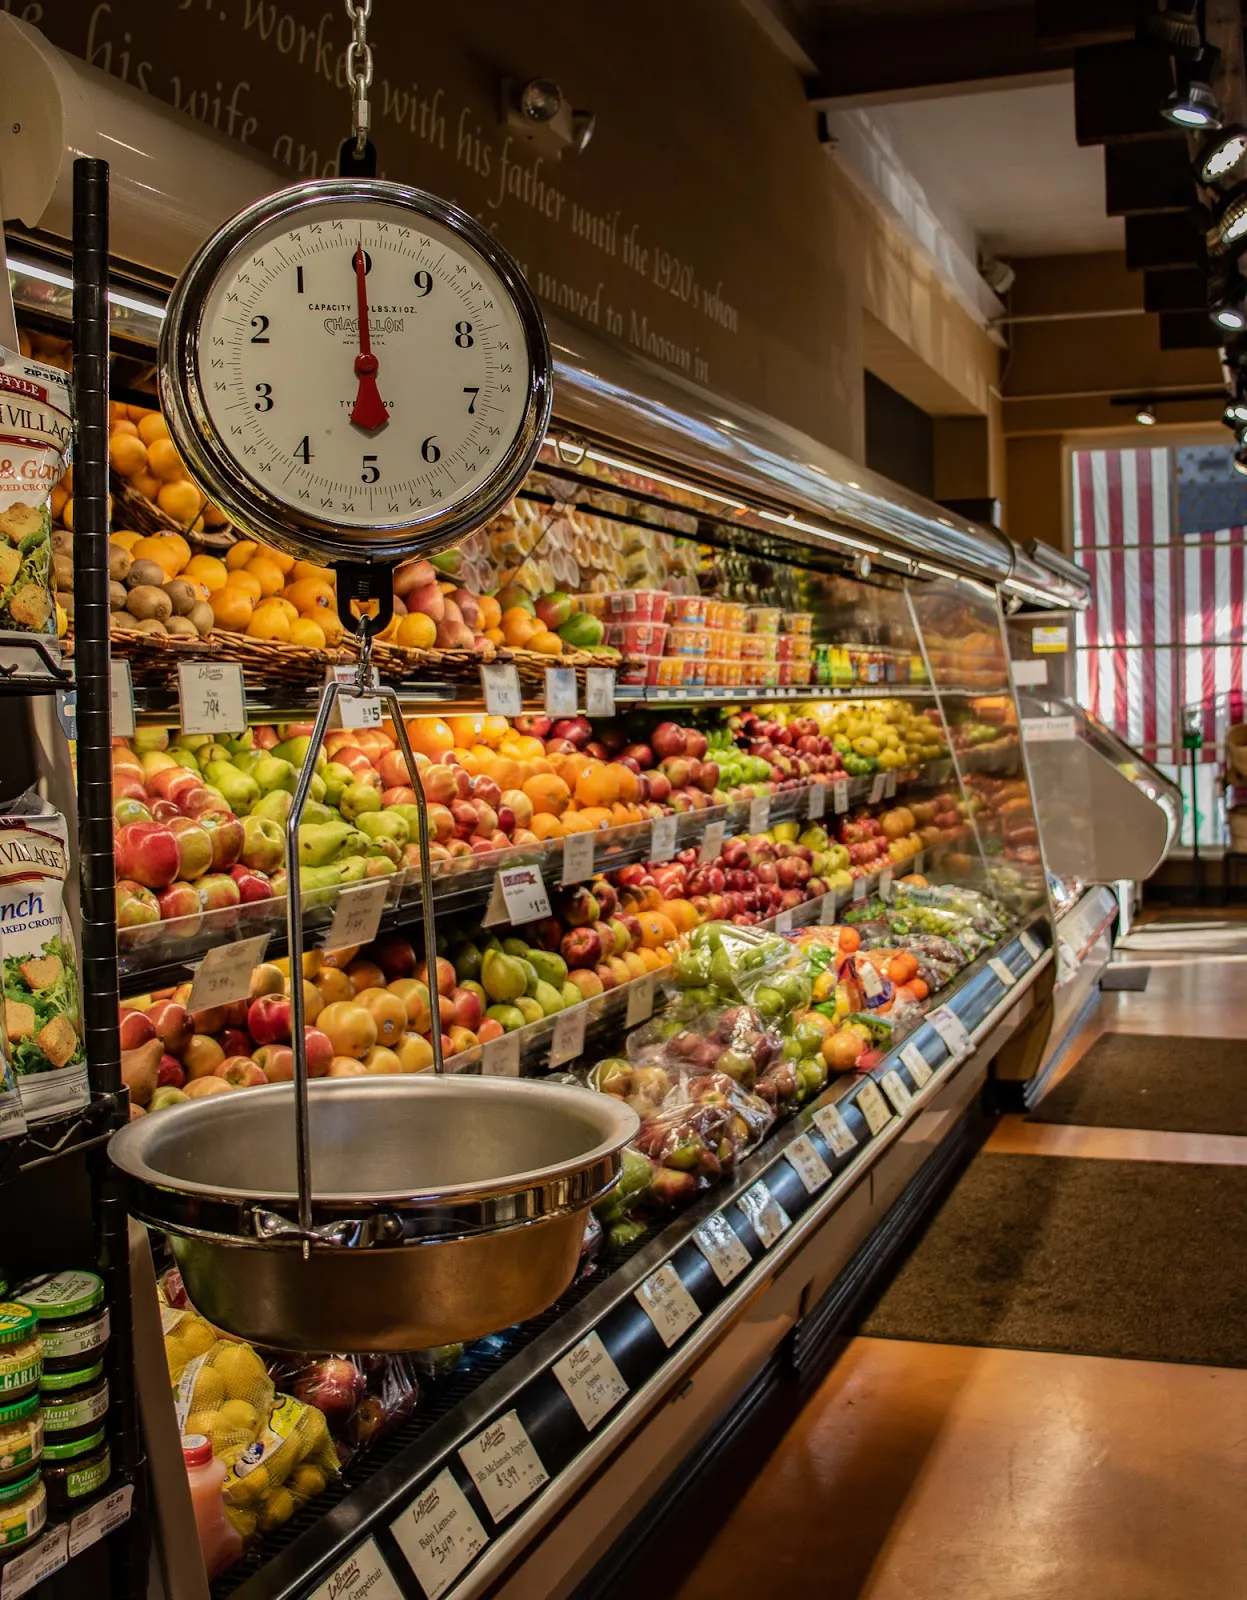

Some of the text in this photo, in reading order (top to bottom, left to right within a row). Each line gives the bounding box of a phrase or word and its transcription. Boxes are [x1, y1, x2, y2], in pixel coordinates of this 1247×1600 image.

[382, 79, 446, 150] with
[457, 107, 493, 177] his
[488, 138, 566, 219] father
[571, 211, 622, 257] until
[623, 225, 650, 273] the
[653, 247, 700, 309] 1920's
[297, 266, 305, 293] 1
[414, 270, 433, 297] 9
[308, 303, 352, 312] CAPACITY
[537, 271, 604, 320] moved
[251, 315, 270, 343] 2
[323, 317, 405, 336] CHATLLON
[455, 321, 473, 348] 8
[255, 383, 273, 412] 3
[463, 387, 480, 414] 7
[293, 436, 314, 464] 4
[421, 435, 441, 463] 6
[361, 455, 380, 483] 5
